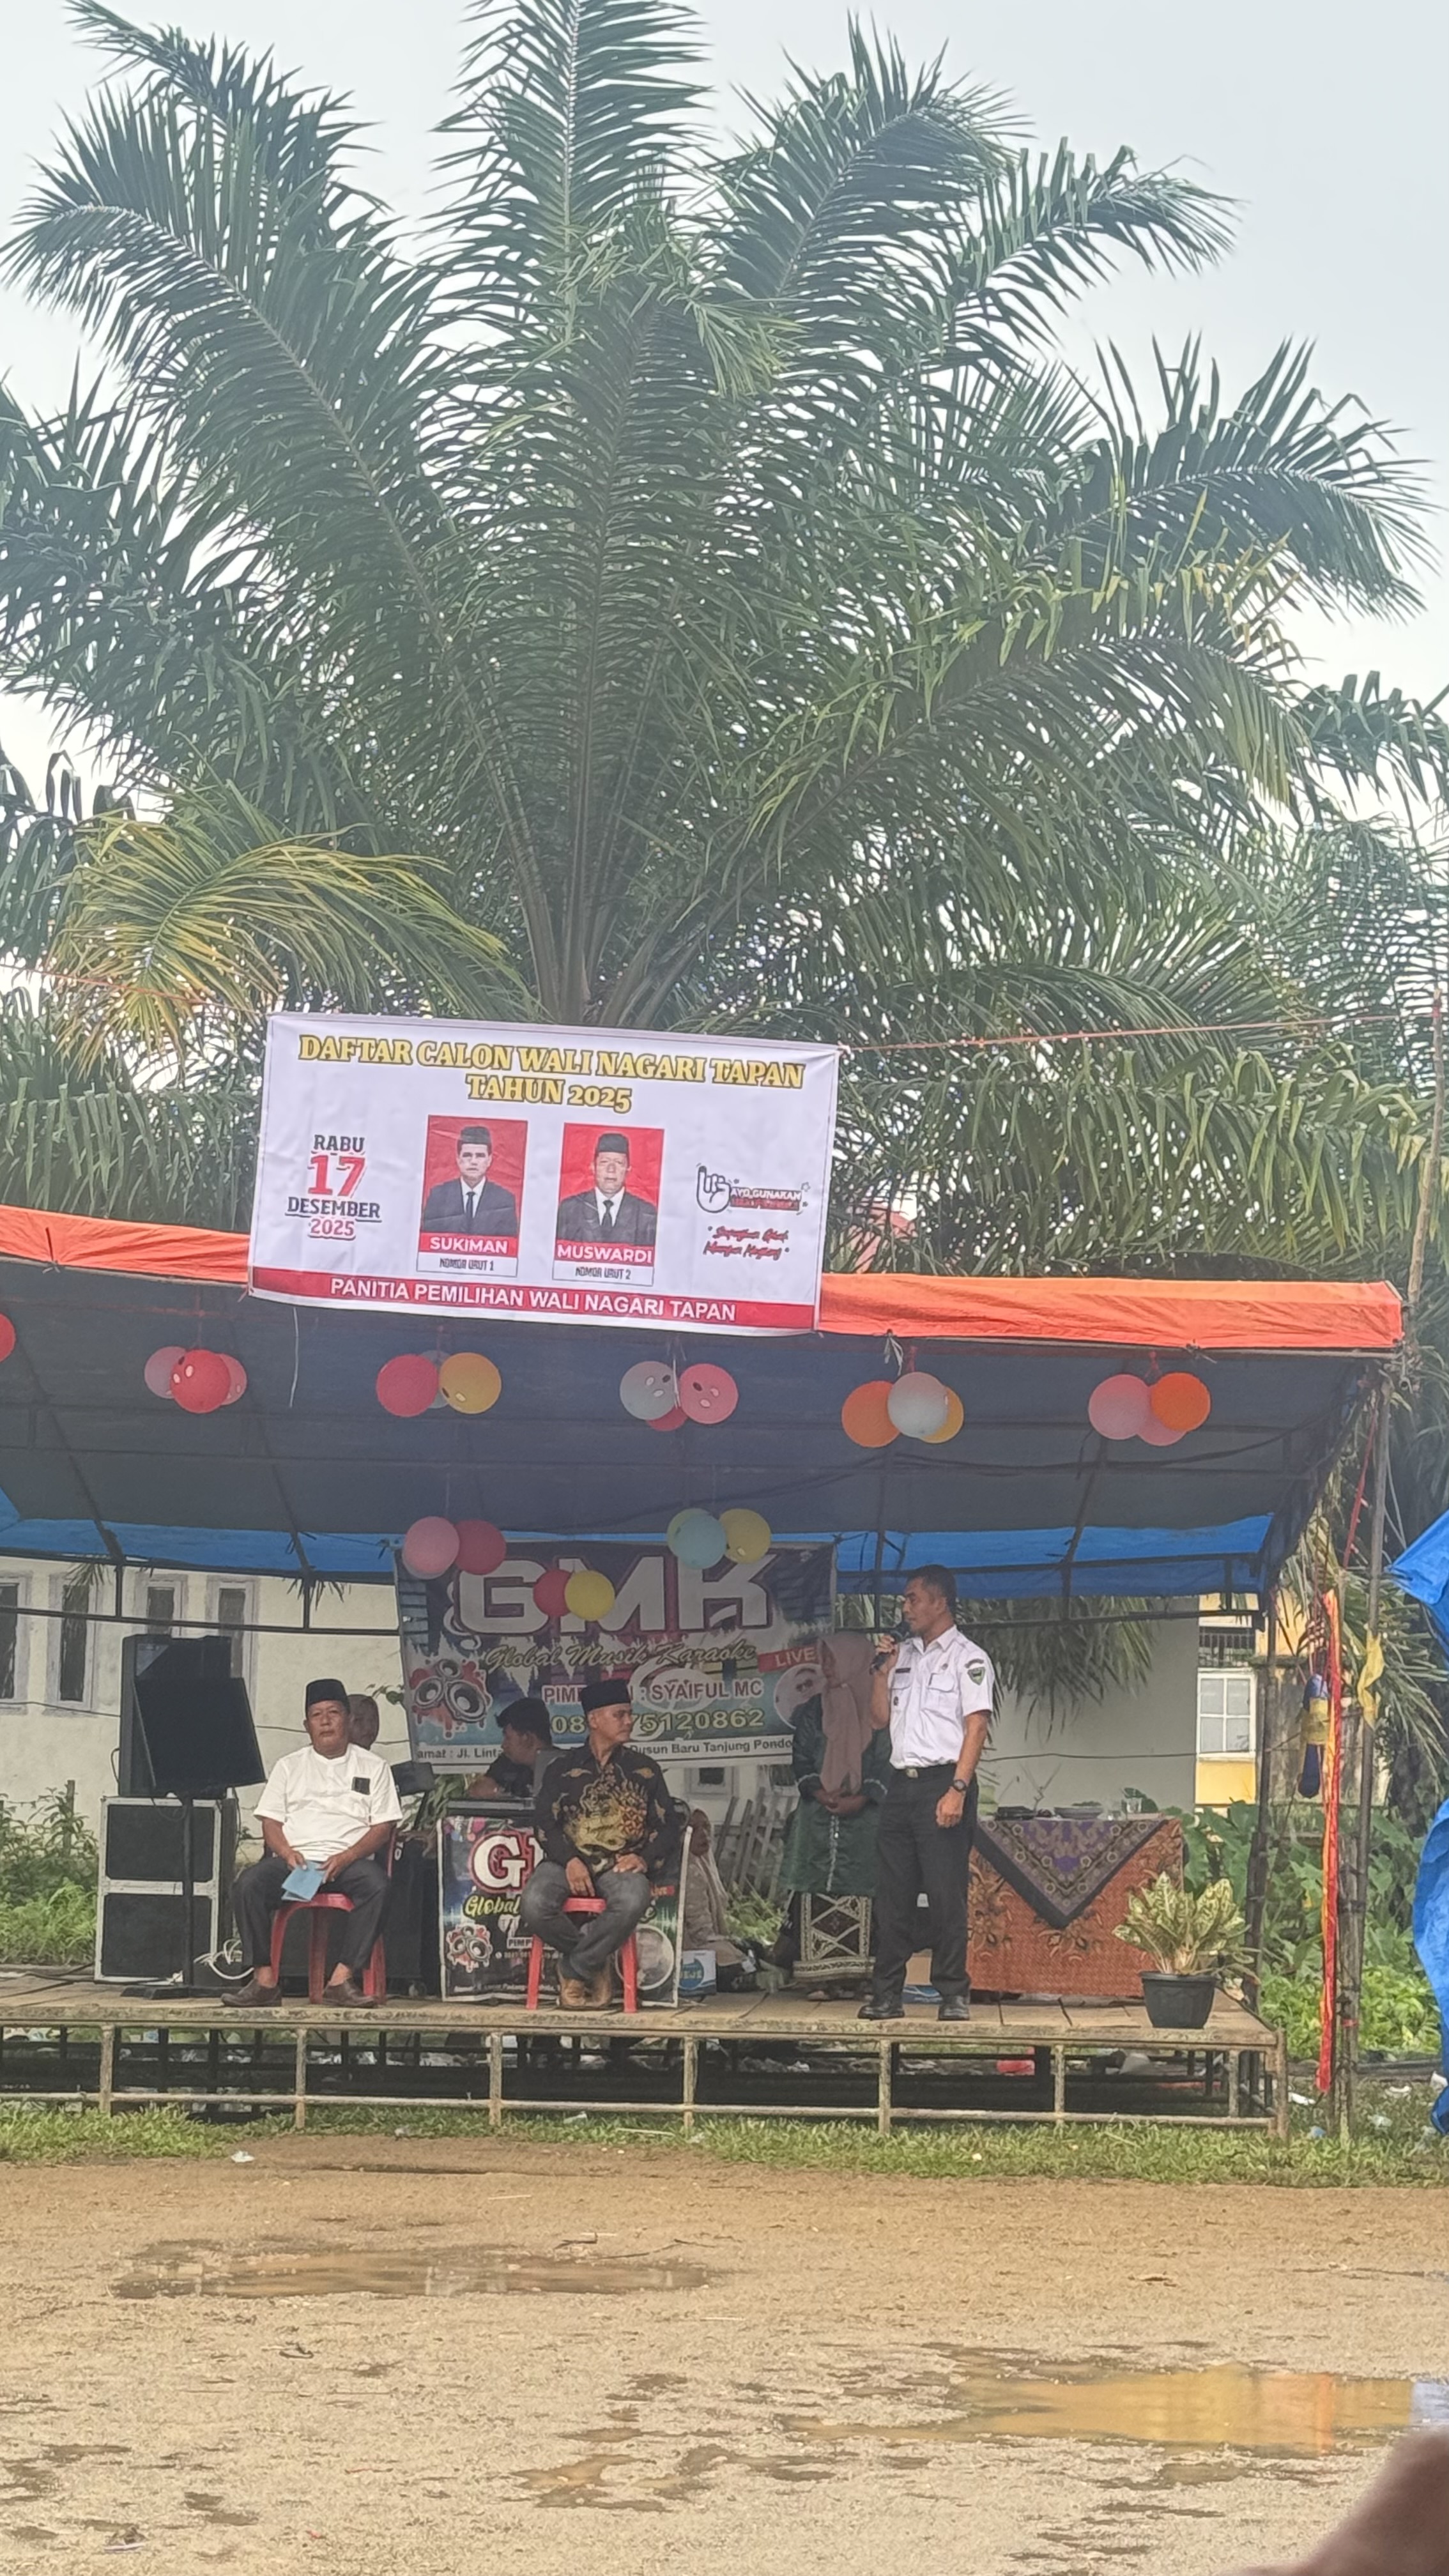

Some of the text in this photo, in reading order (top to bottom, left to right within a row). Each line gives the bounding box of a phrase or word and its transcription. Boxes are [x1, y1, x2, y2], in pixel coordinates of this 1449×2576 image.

[298, 1034, 806, 1089] DAFTAR CALON WALI NAGARI TAPAN
[465, 1073, 632, 1114] TAHUN 2025
[312, 1135, 365, 1153] RABU
[307, 1155, 365, 1197] 17
[287, 1197, 381, 1218] DESEMBER
[310, 1218, 355, 1236] 2025
[429, 1236, 509, 1254] SUKIMAN
[556, 1245, 652, 1264] MUSWARDI
[440, 1257, 466, 1269] NOMOR
[489, 1261, 494, 1271] 1
[575, 1266, 602, 1278] NOMOR
[625, 1269, 631, 1280] 2
[330, 1278, 735, 1321] PANITIA PEMILIHAN WALI NAGARI TAPAN
[456, 1553, 777, 1634] GMK
[484, 1639, 757, 1671] Global Musik Karaoke
[775, 1647, 816, 1667] LIVE
[652, 1680, 729, 1701] SYAIFUL
[734, 1679, 763, 1697] MC
[417, 1748, 447, 1759] amat
[671, 1743, 700, 1753] Baru
[703, 1742, 750, 1752] Tanjung
[754, 1738, 792, 1750] Pondo
[464, 1895, 521, 1917] Global
